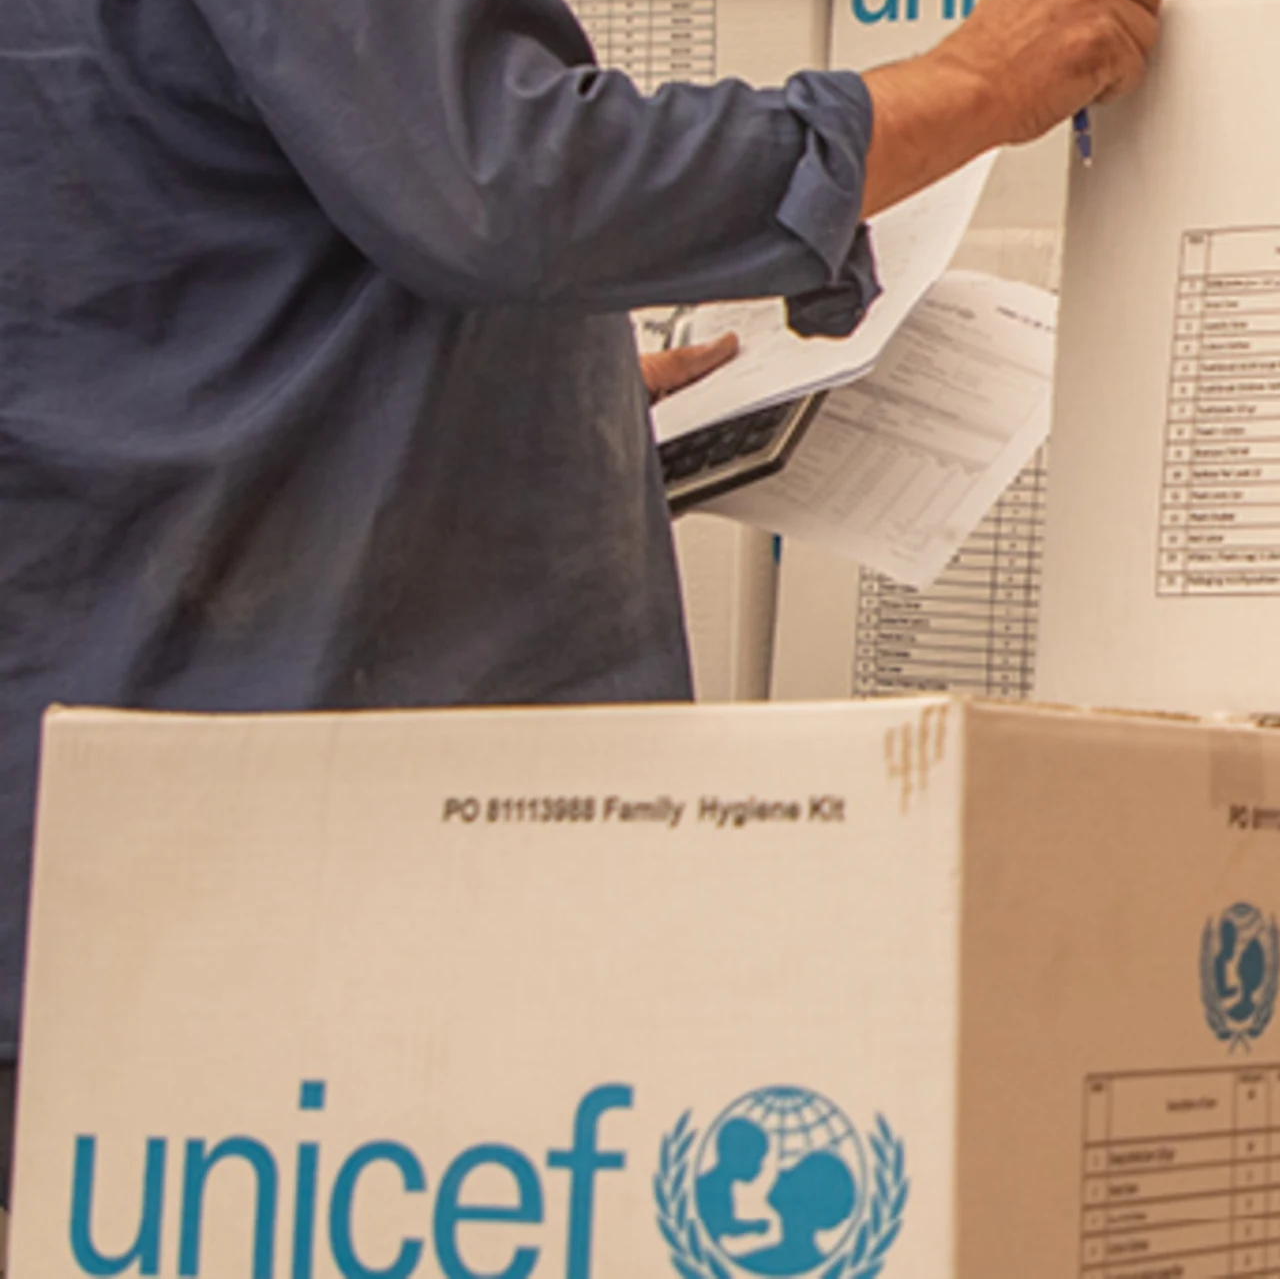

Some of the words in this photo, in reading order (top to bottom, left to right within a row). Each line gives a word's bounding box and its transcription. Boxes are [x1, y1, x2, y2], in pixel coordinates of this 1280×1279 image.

[442, 795, 482, 824] PO
[602, 793, 688, 832] Family
[698, 794, 802, 831] Hygiene
[807, 793, 847, 823] Kit
[68, 1078, 636, 1279] unicef
